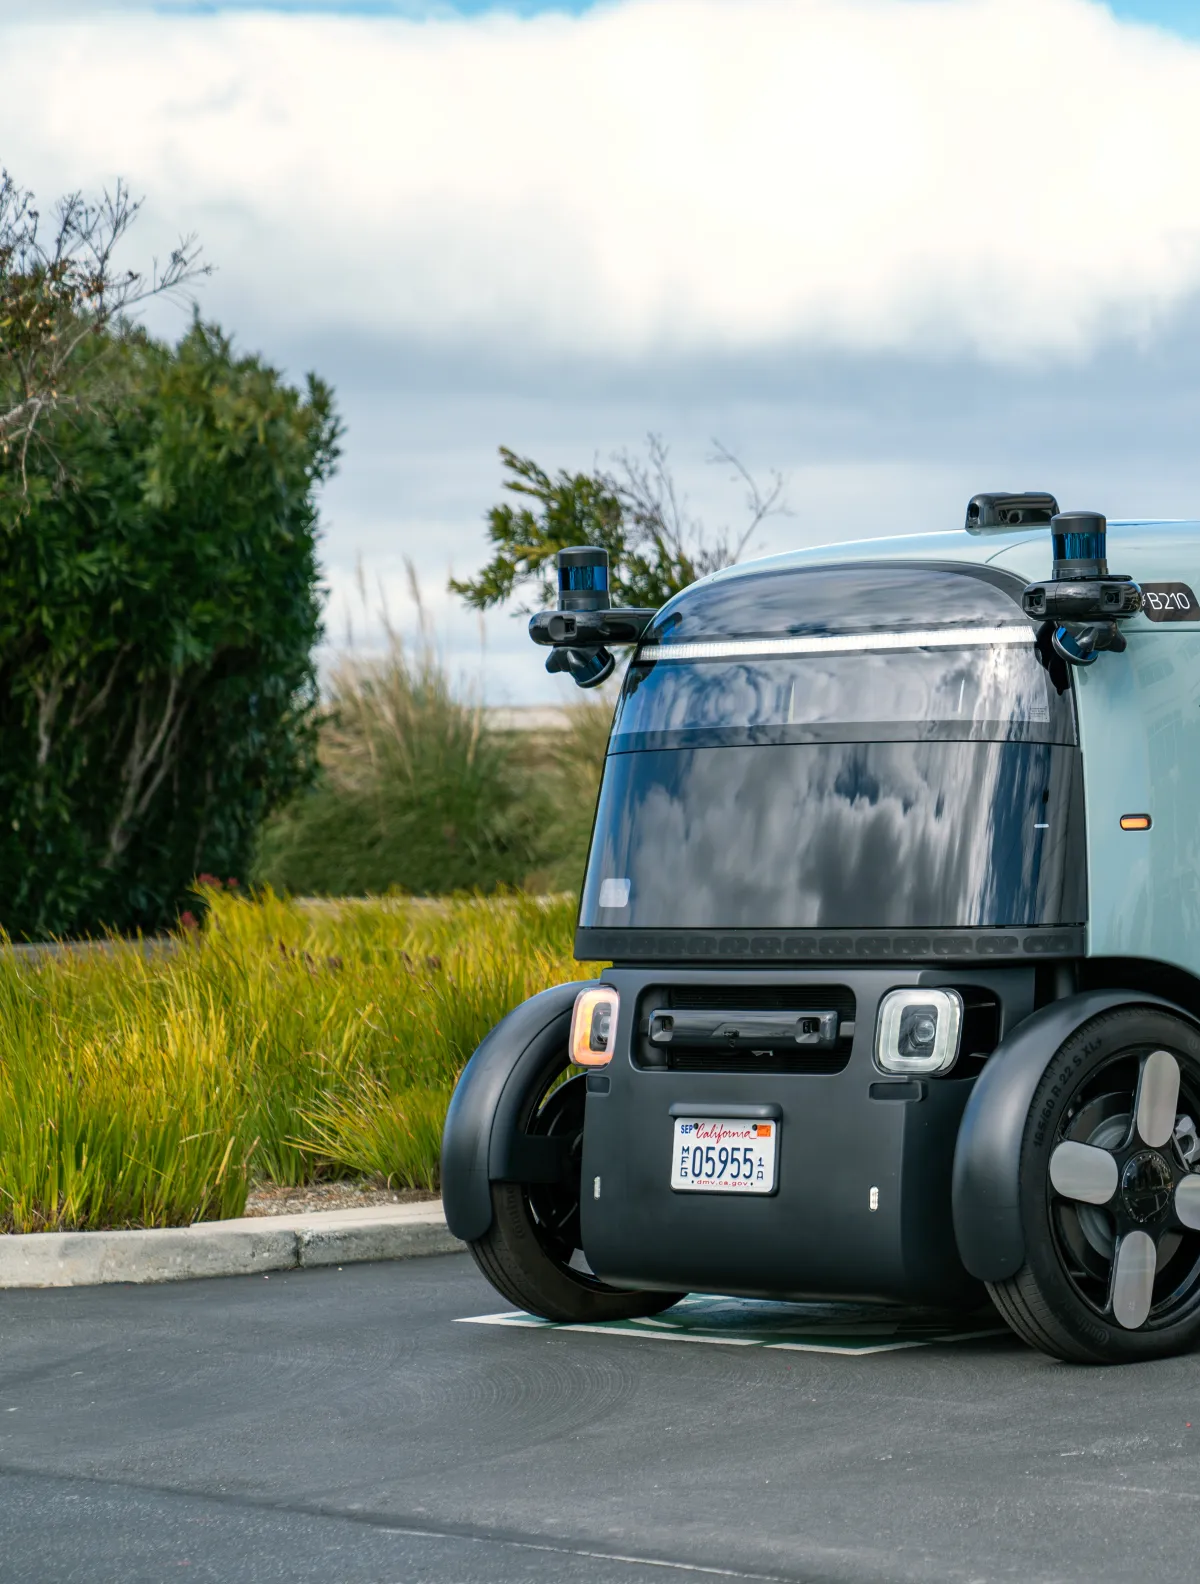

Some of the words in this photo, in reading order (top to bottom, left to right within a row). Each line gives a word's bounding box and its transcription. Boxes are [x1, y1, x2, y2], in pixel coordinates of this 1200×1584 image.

[1146, 592, 1191, 610] B210
[680, 1124, 694, 1134] SEP
[695, 1122, 757, 1144] California
[680, 1145, 690, 1178] MFG
[691, 1145, 754, 1179] 05955
[696, 1179, 748, 1187] dmv.ca.gov
